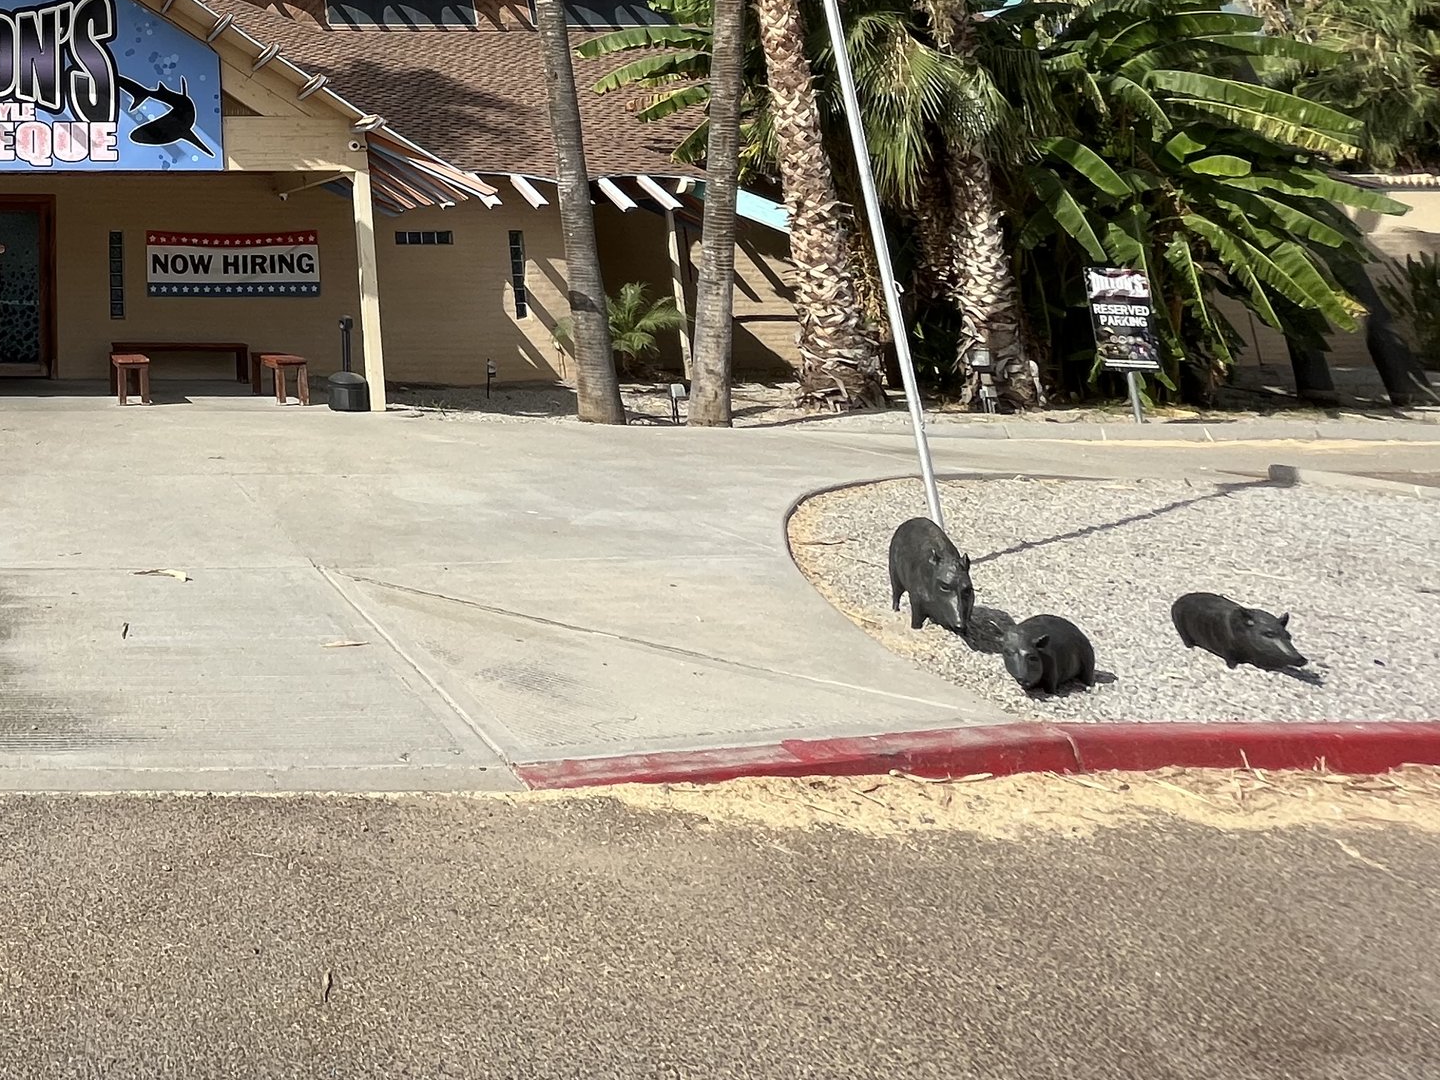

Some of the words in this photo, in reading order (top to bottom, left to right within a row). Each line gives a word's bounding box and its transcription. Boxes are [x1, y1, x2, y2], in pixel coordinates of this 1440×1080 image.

[152, 253, 213, 275] NOW
[222, 253, 315, 275] HIRING
[1092, 303, 1150, 317] RESERVED
[1099, 315, 1148, 327] PARKING
